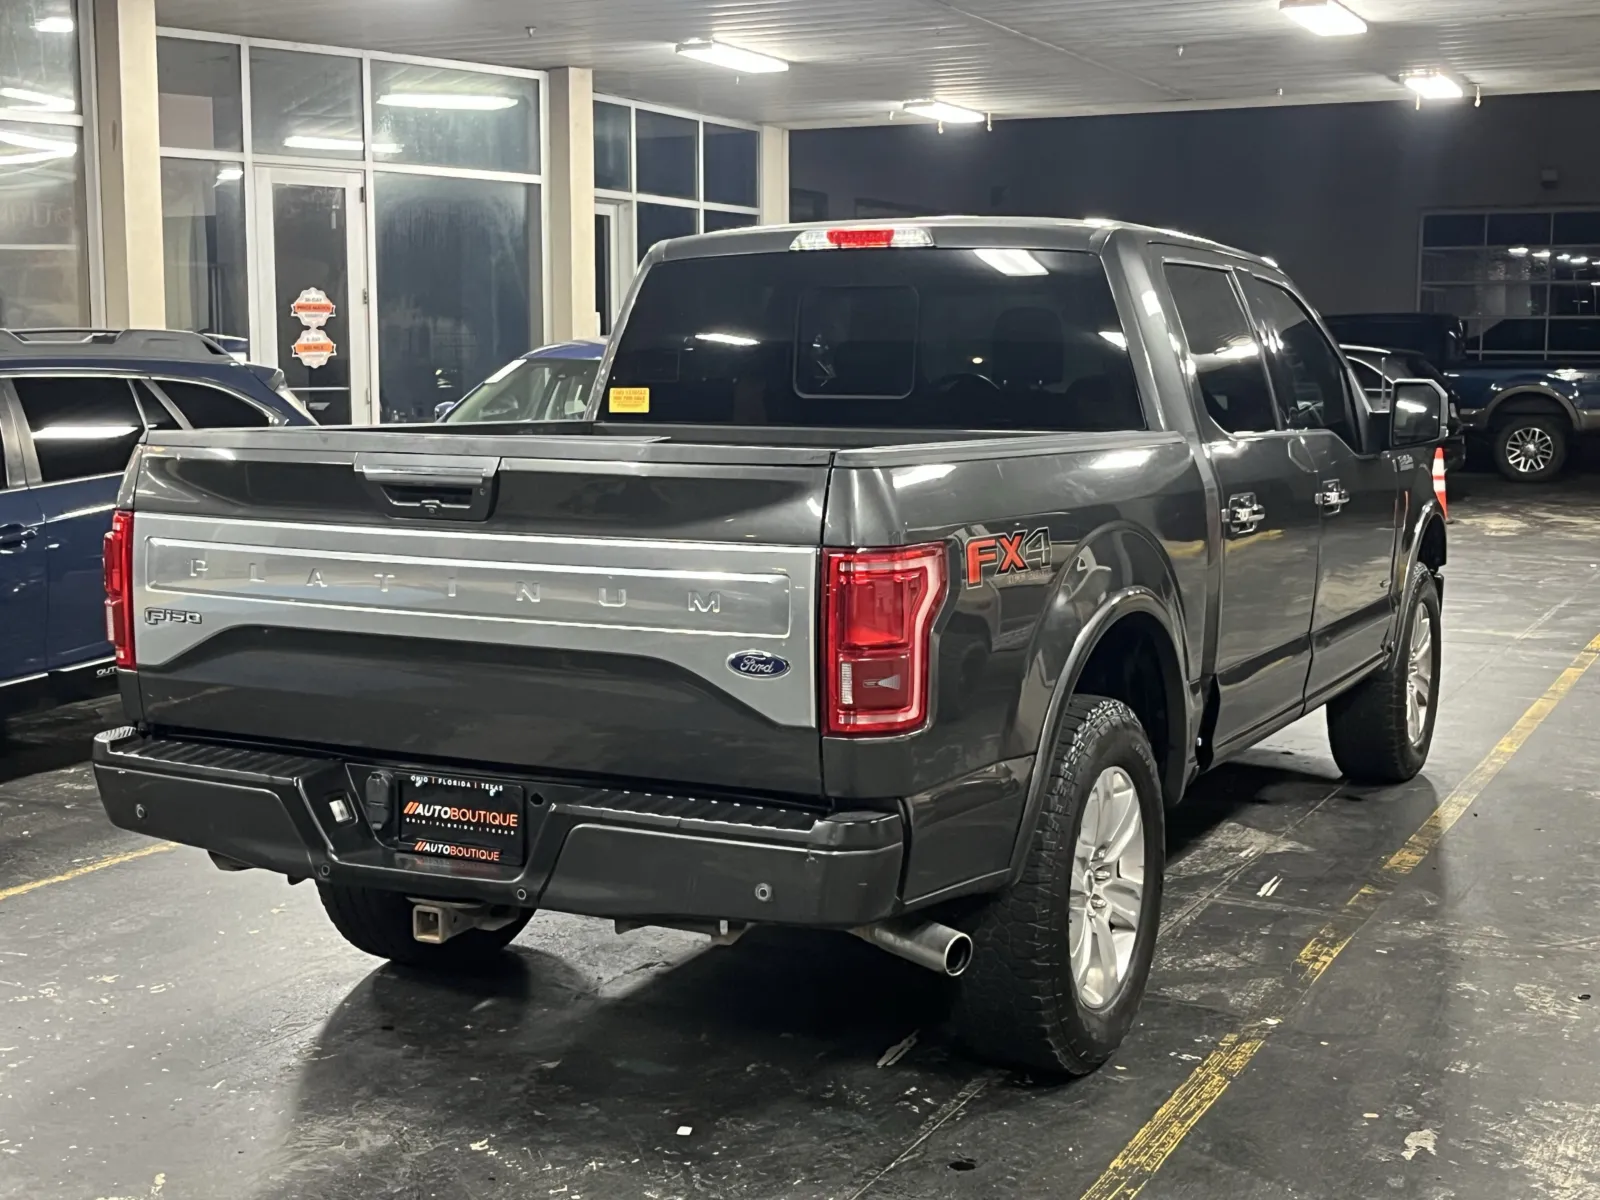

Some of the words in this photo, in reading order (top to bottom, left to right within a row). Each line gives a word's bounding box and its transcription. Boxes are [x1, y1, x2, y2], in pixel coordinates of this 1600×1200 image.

[188, 558, 722, 614] PLATINUM
[964, 526, 1052, 590] FX4
[438, 778, 471, 788] FLORIDA
